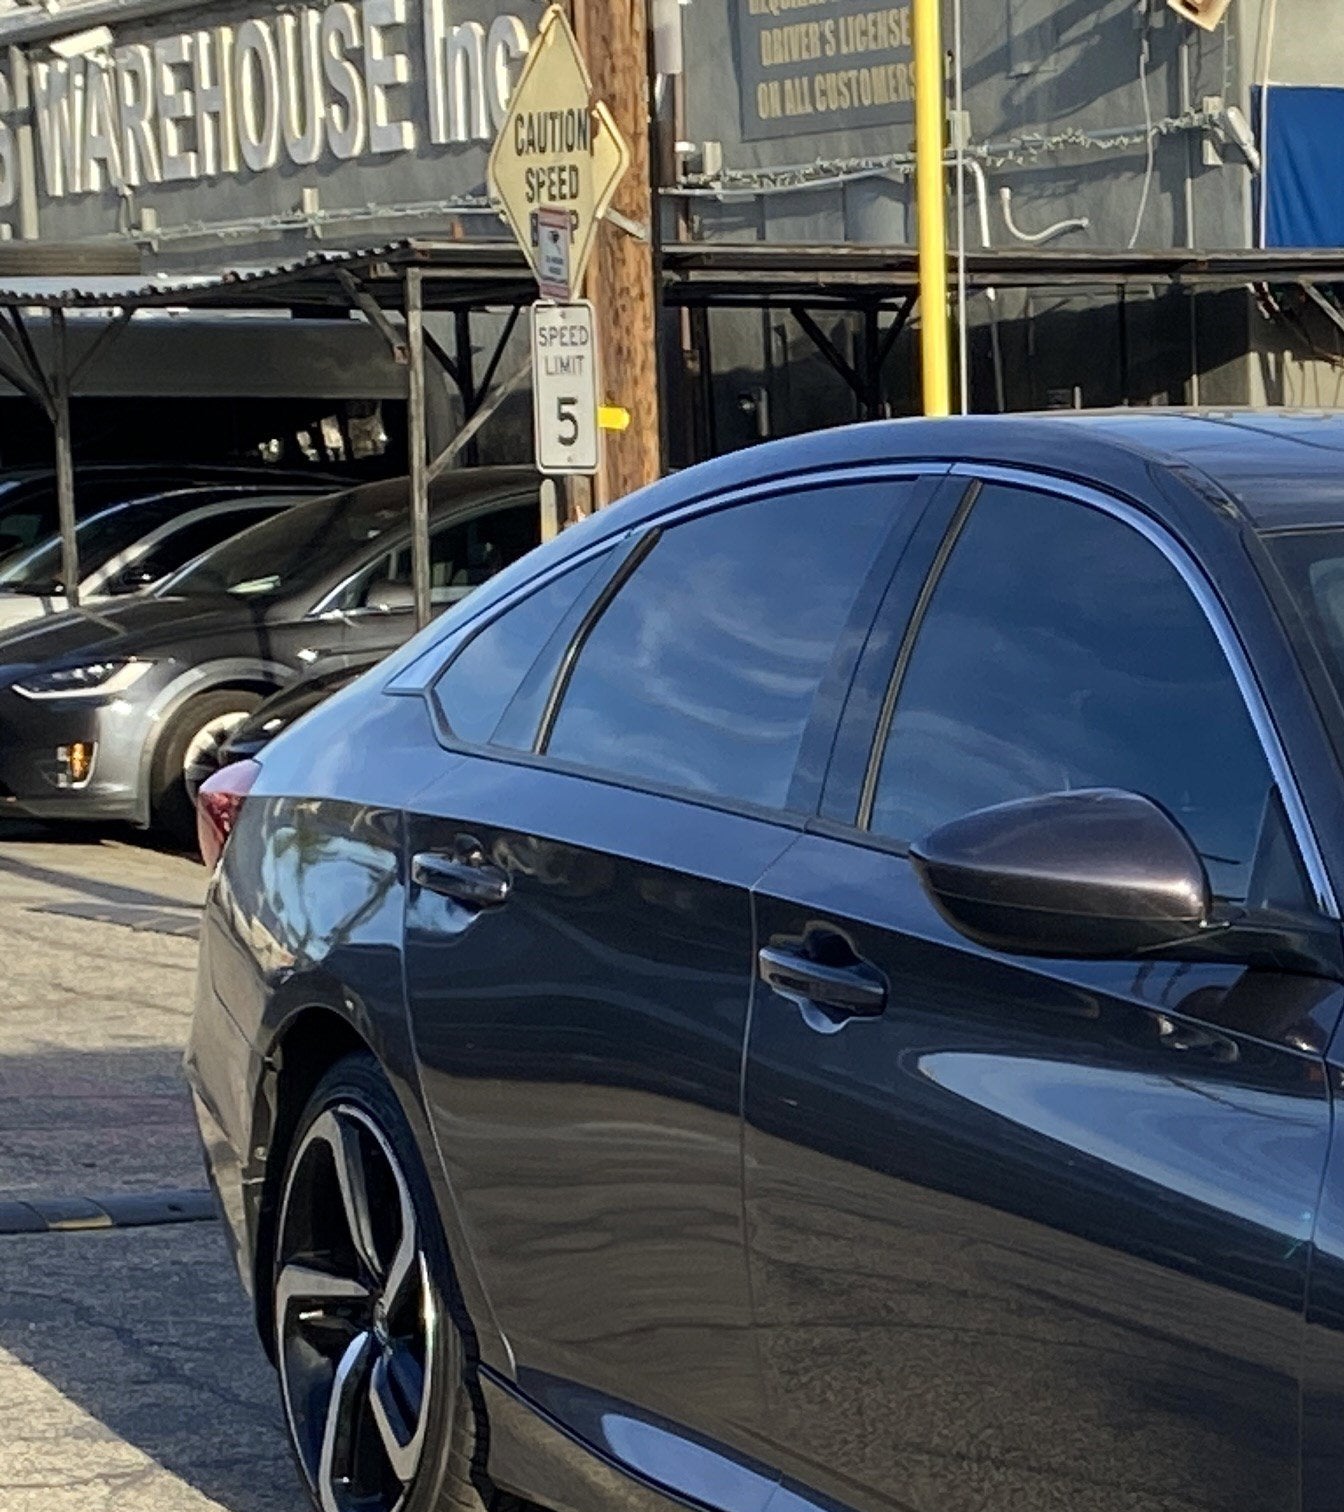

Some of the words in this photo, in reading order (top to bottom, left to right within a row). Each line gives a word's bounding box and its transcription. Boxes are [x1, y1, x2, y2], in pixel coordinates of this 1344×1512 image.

[761, 18, 836, 68] DRIVER'S
[838, 6, 912, 54] LICENSE
[33, 0, 416, 196] WAREHOUSE
[784, 75, 814, 116] ALL
[814, 61, 917, 112] CUSTOMERS
[514, 108, 592, 156] CAUTION
[525, 165, 579, 203] SPEED
[529, 210, 579, 247] BP
[538, 325, 589, 347] SPEED
[544, 355, 584, 377] LIMIT
[556, 396, 579, 447] 5
